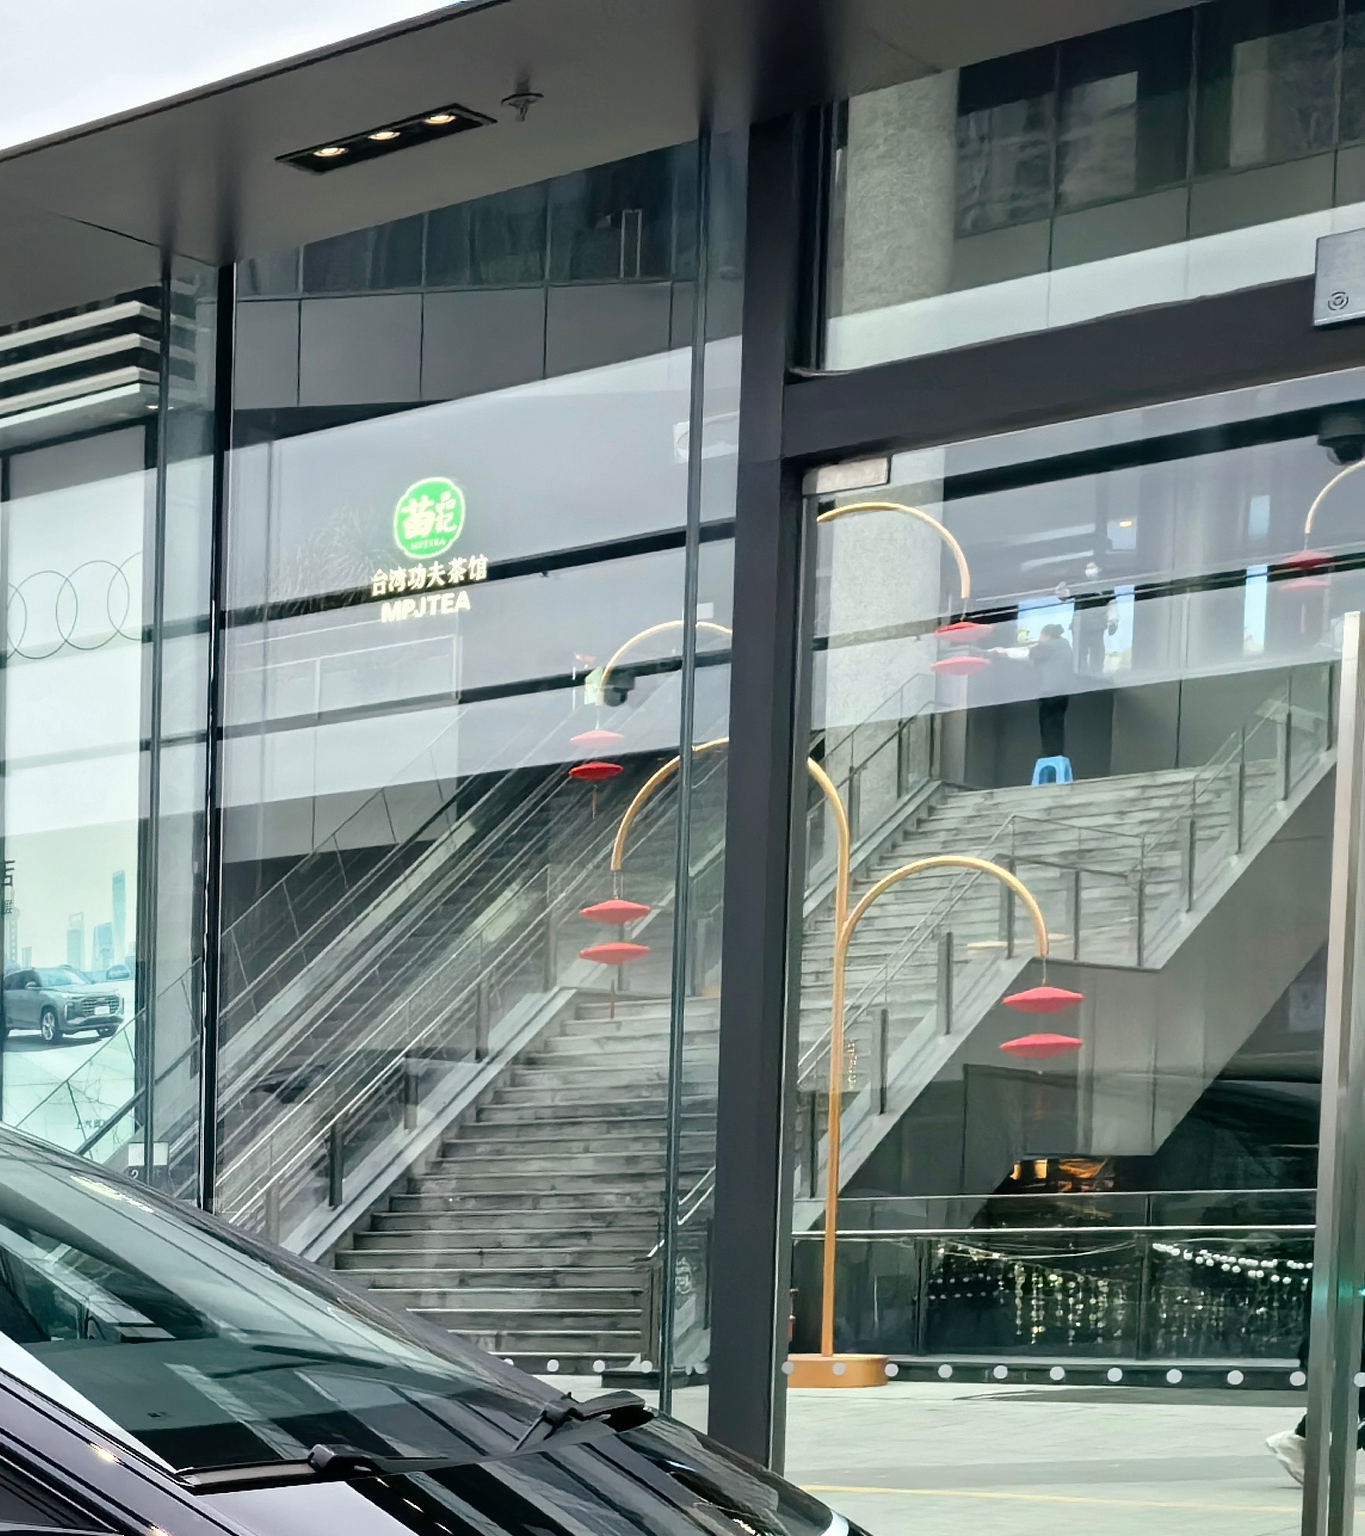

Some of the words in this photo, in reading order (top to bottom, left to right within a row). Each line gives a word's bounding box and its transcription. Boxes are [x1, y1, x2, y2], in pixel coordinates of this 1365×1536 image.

[371, 553, 488, 597] 台湾功夫茶馆
[381, 590, 471, 623] MPJTEA
